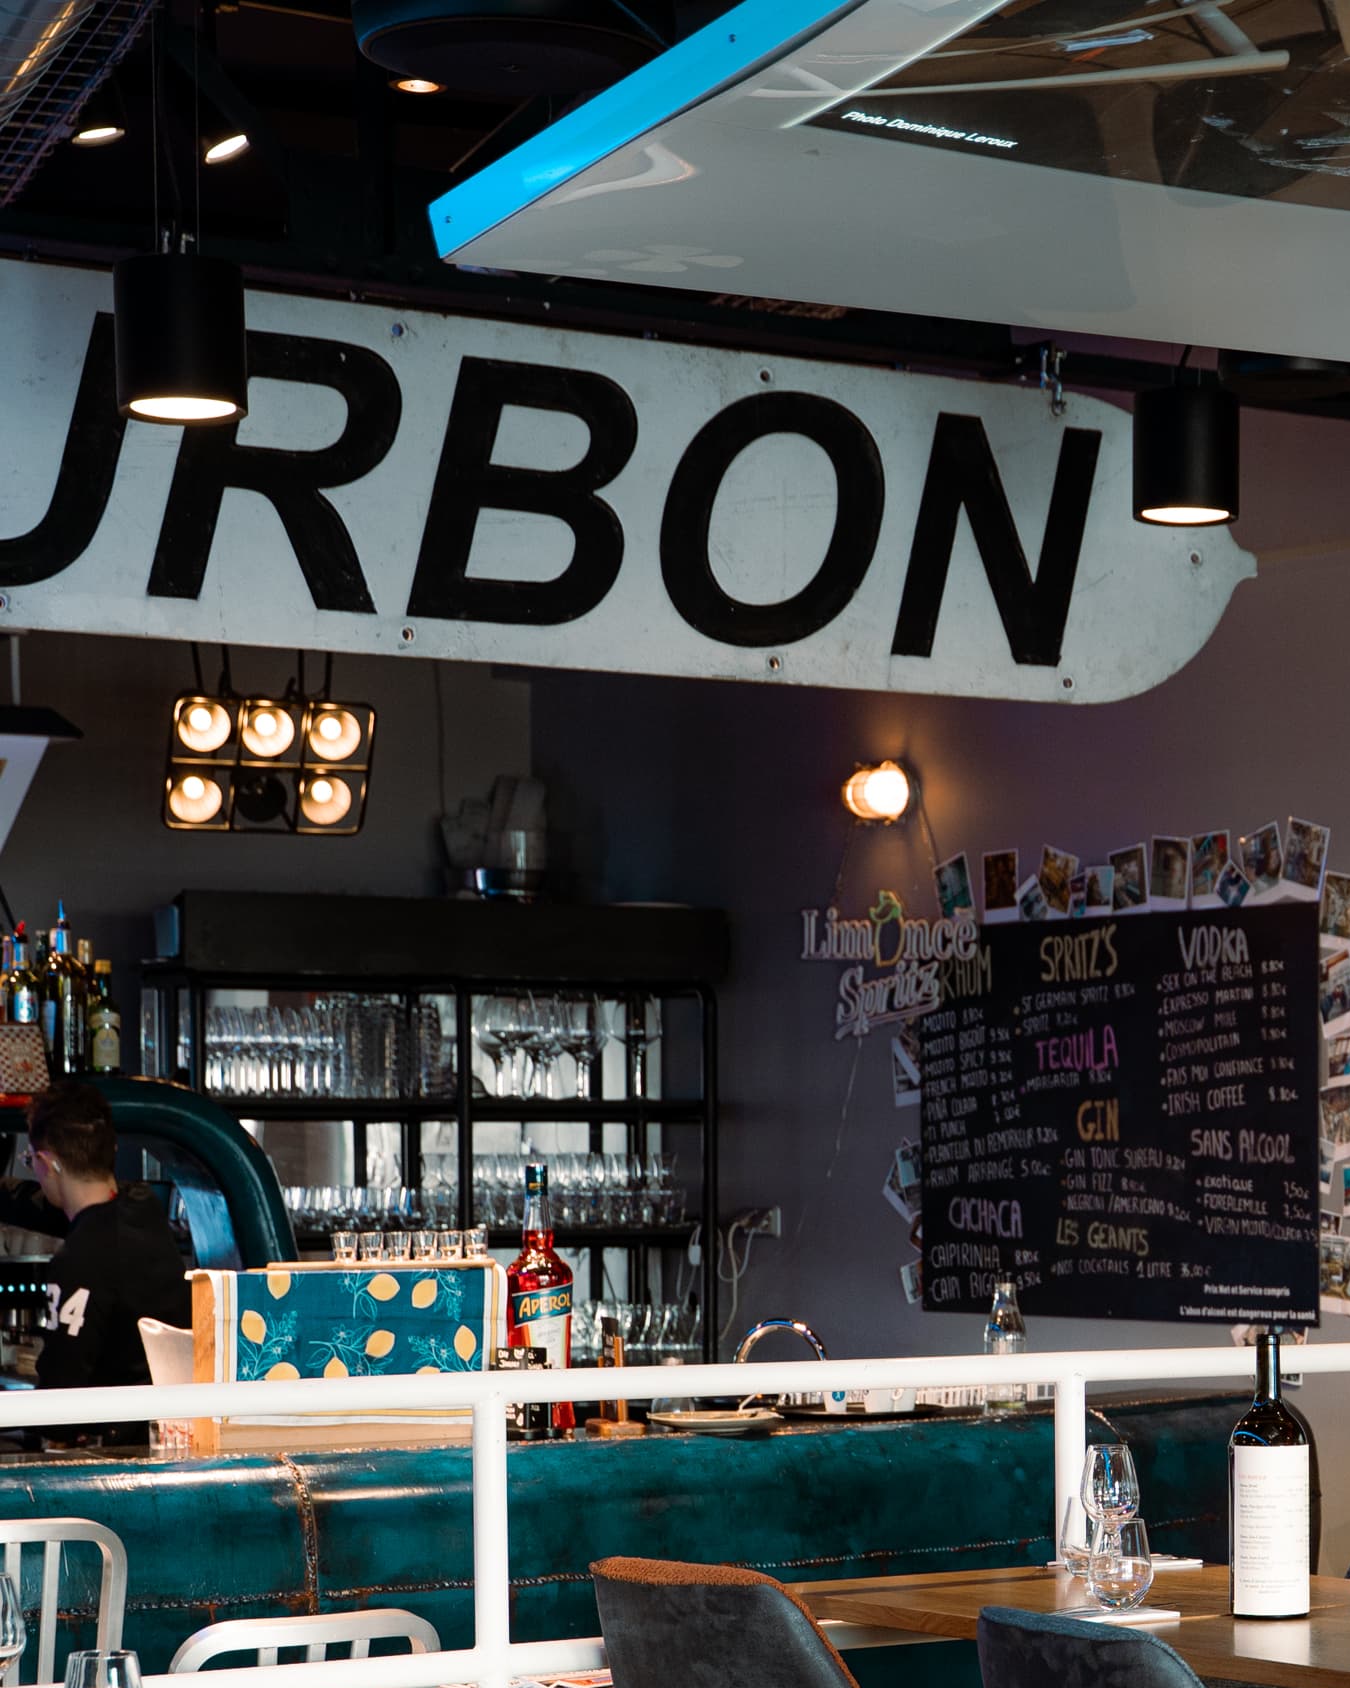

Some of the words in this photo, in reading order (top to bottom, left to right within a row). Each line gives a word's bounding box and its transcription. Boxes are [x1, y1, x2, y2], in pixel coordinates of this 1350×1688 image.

[841, 111, 888, 125] Photo
[886, 118, 966, 138] Dominique
[964, 133, 1019, 148] Leroux
[1177, 925, 1250, 970] VODKA
[1035, 1024, 1119, 1072] TEQUILA
[1207, 1084, 1247, 1110] COFFEE
[1076, 1097, 1120, 1143] GIN
[1064, 1147, 1085, 1168] GIN
[1190, 1128, 1232, 1162] SANS
[1239, 1128, 1296, 1165] ALCOOL
[930, 1242, 1001, 1269] CAIPIRINHA
[46, 1283, 90, 1337] 34
[518, 1292, 572, 1319] APEROL
